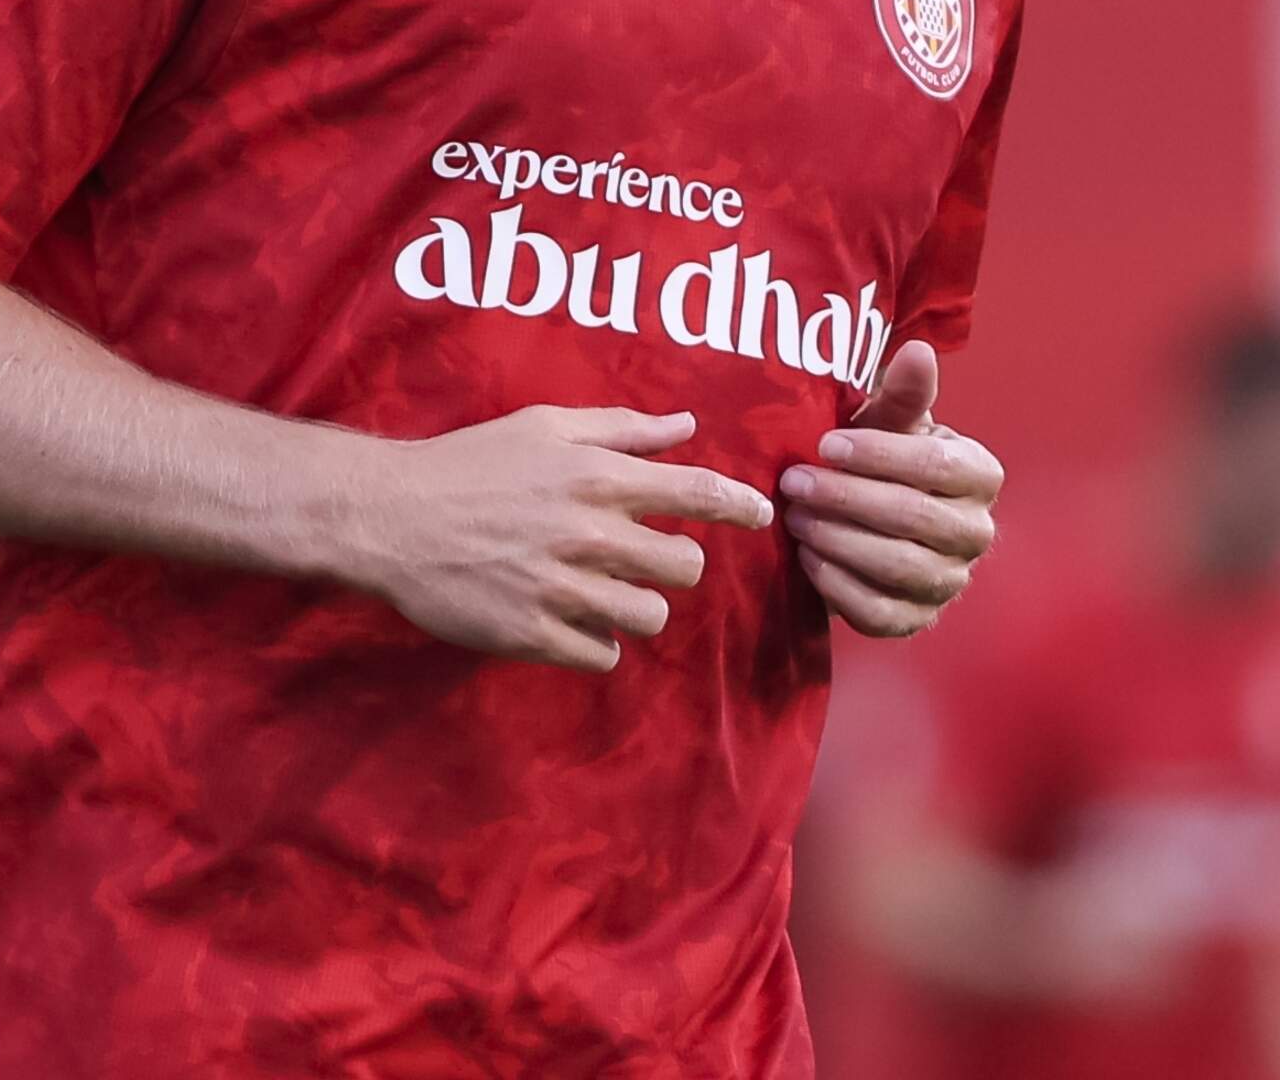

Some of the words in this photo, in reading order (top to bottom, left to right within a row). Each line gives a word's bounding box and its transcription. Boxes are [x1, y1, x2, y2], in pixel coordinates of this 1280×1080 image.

[900, 45, 940, 87] FUTBOL
[431, 141, 745, 228] experience
[393, 203, 642, 334] abu
